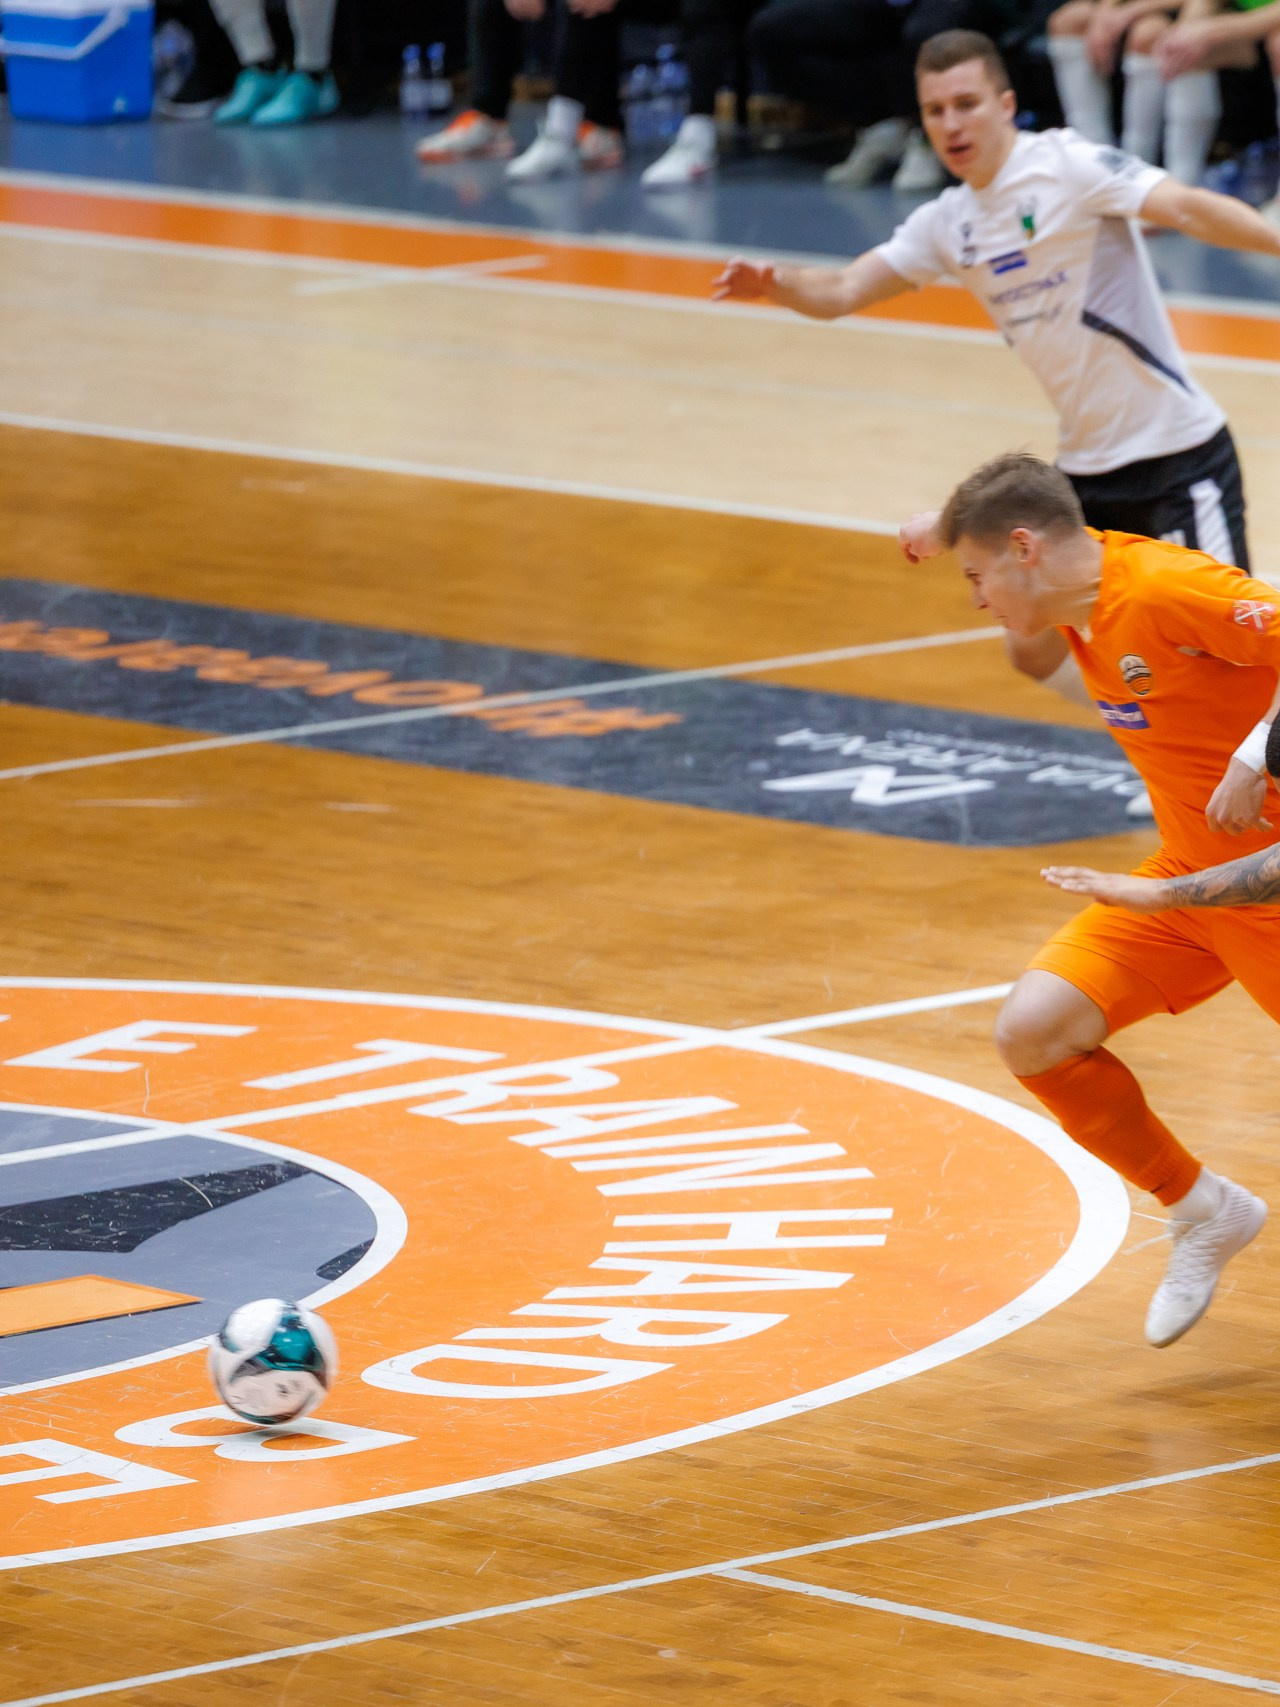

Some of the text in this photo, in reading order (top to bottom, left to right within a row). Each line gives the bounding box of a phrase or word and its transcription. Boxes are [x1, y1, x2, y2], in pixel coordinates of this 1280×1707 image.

[1026, 763, 1147, 797] OVA
[0, 1014, 260, 1074] E
[361, 1206, 894, 1400] HARD
